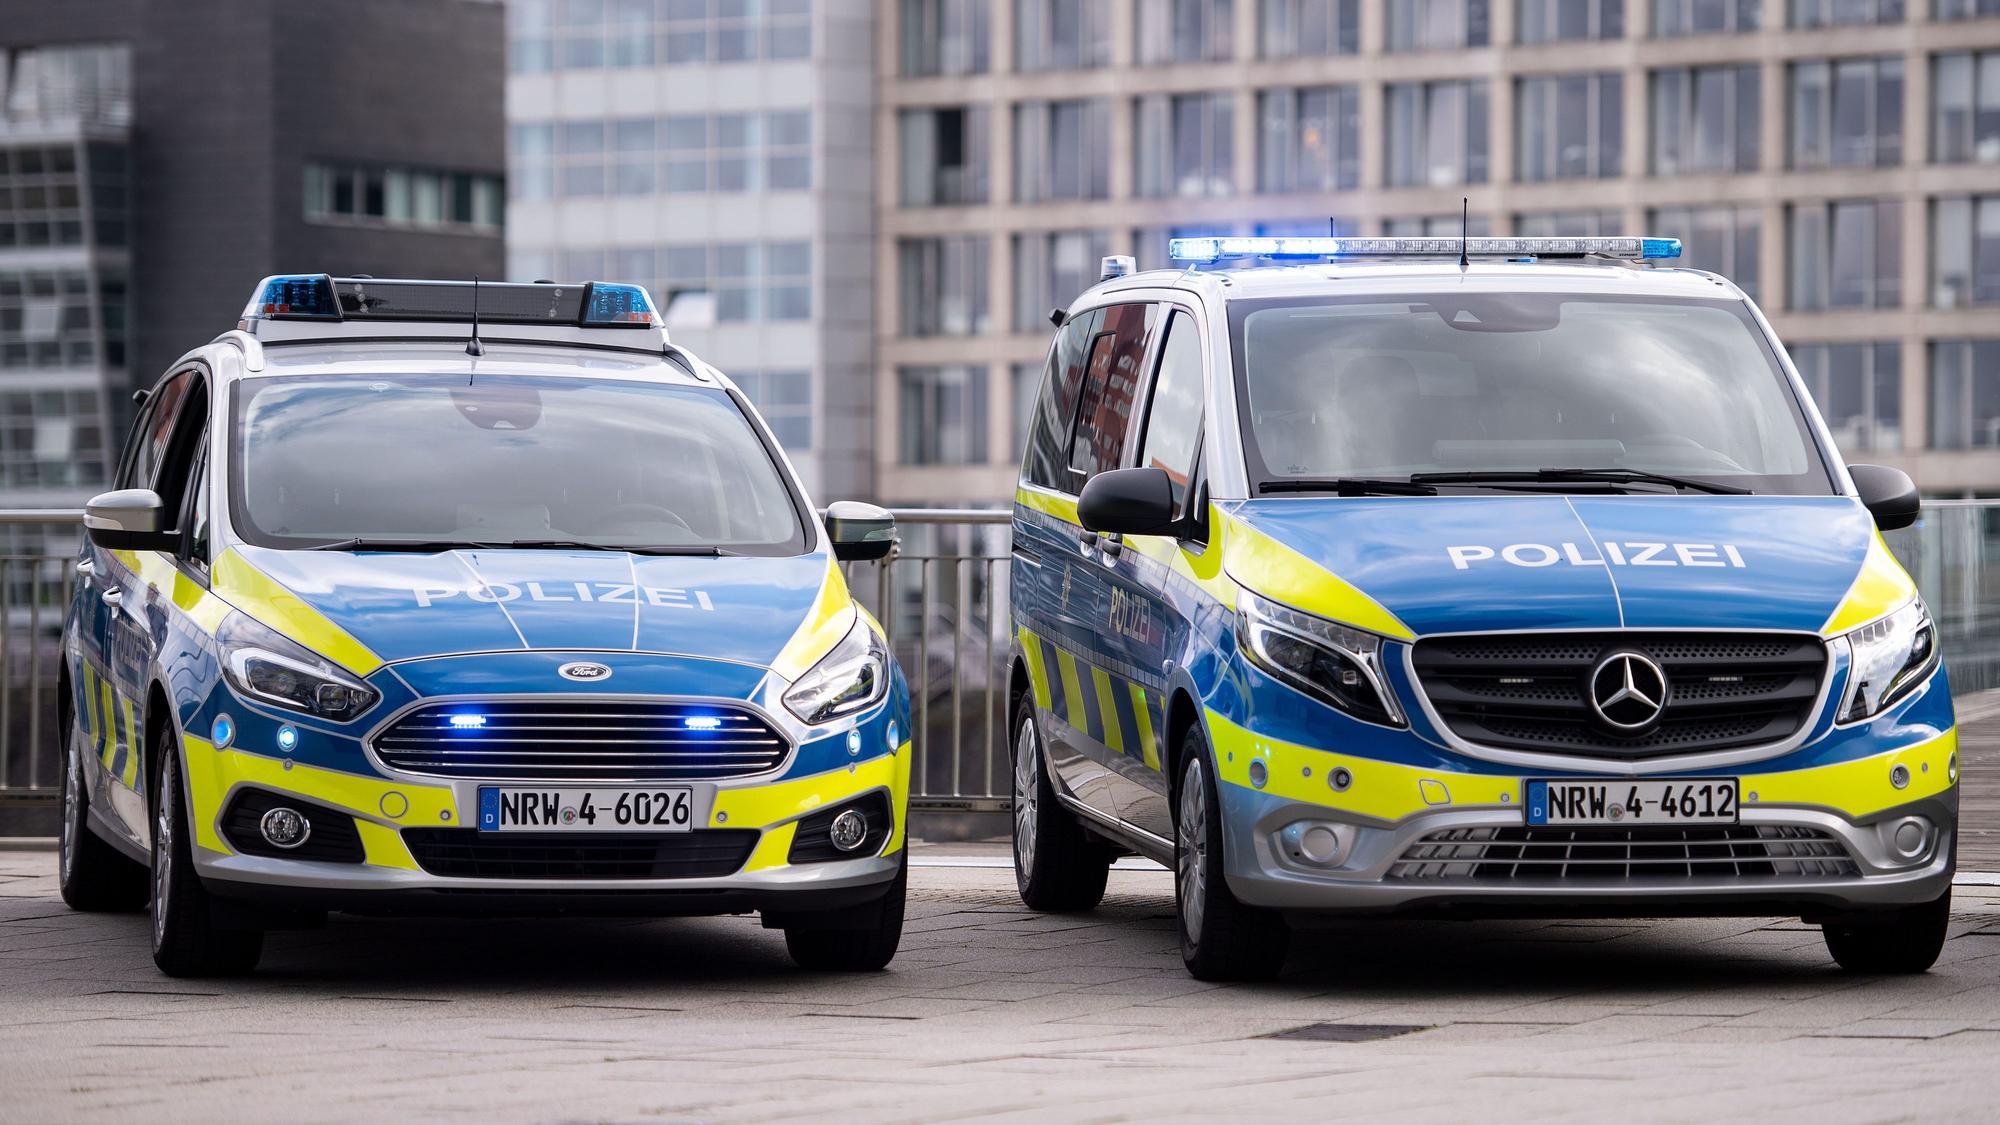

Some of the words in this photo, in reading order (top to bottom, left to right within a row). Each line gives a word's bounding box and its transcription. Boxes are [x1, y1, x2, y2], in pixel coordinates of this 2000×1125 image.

[1446, 541, 1747, 570] POLIZEI
[412, 581, 715, 612] POLIZEI
[1108, 585, 1151, 645] POLIZEI
[501, 792, 561, 825] NRW
[578, 792, 690, 825] 4-6026
[1533, 807, 1542, 817] D
[1548, 786, 1607, 819] NRW
[1625, 784, 1735, 818] 4-4612
[485, 814, 494, 824] D
